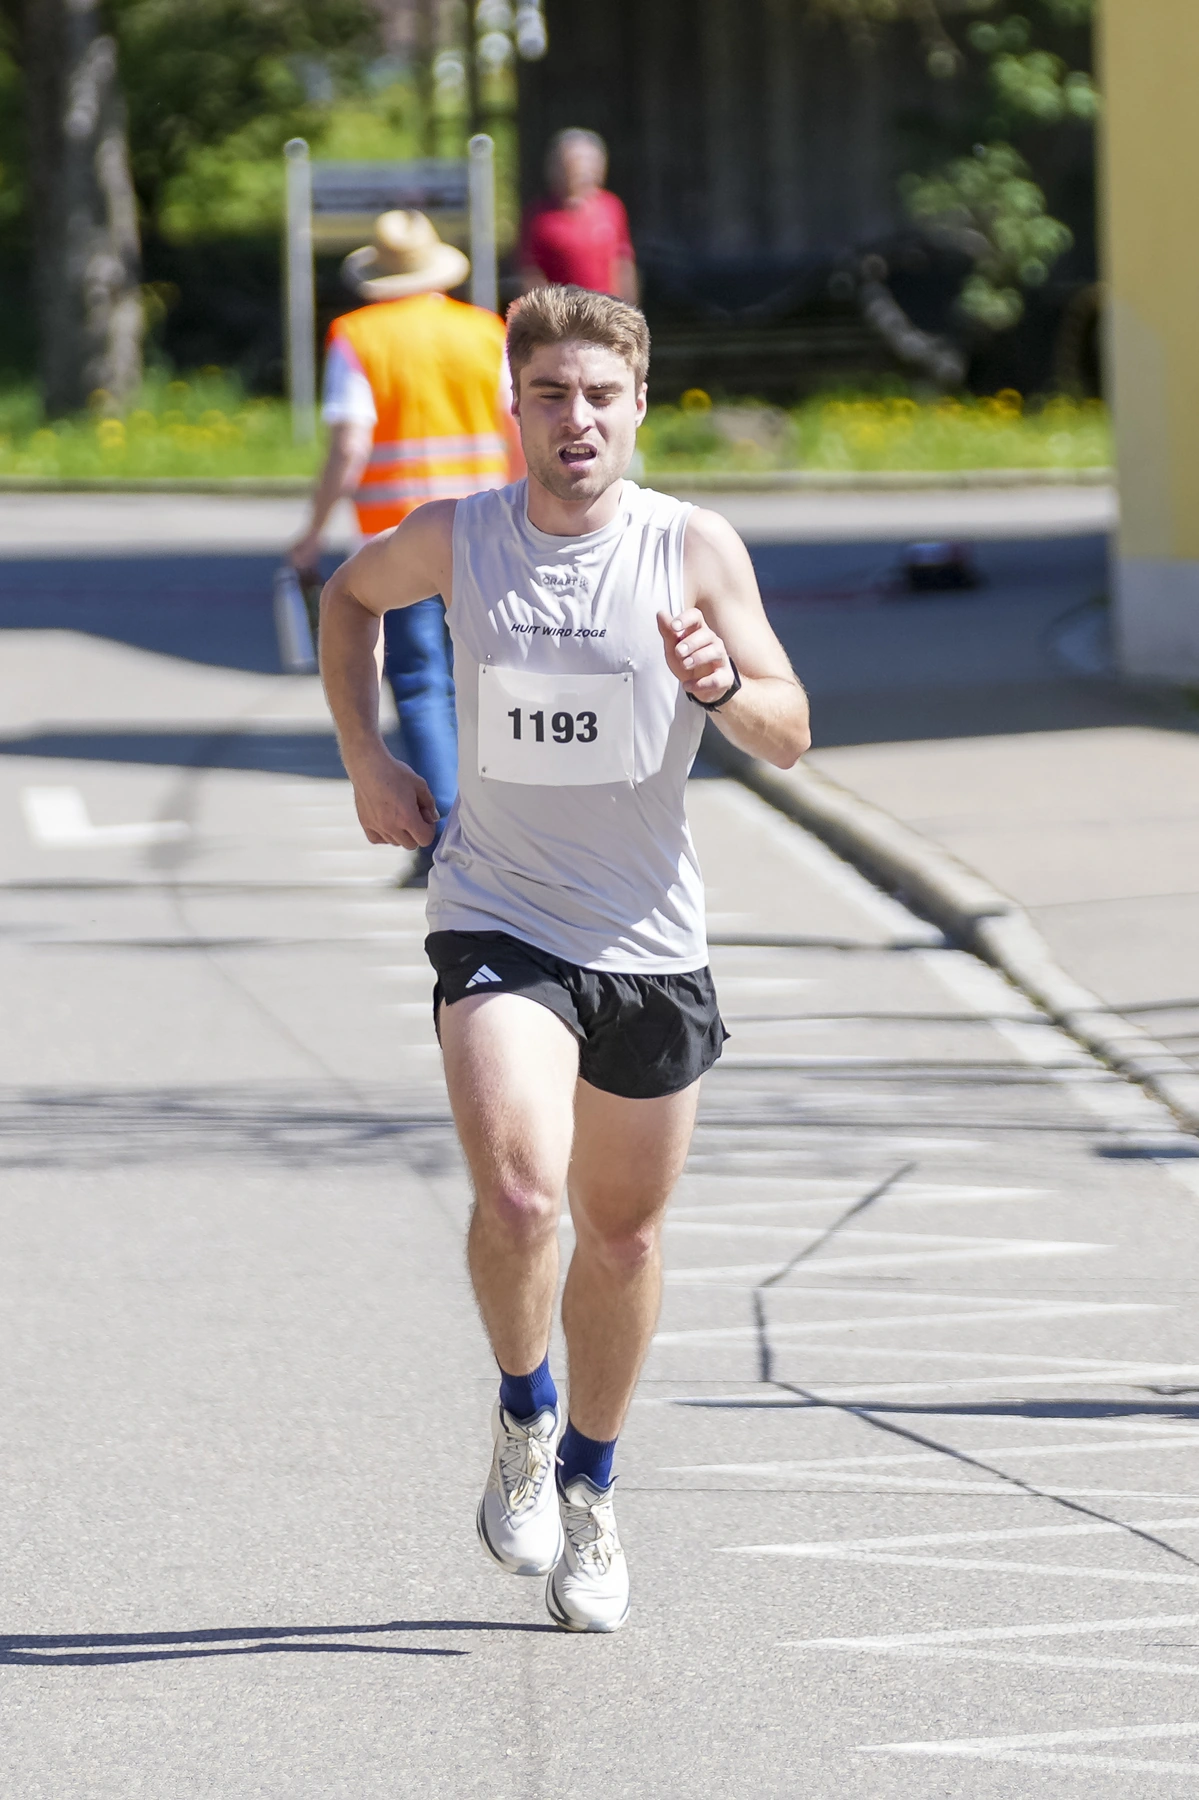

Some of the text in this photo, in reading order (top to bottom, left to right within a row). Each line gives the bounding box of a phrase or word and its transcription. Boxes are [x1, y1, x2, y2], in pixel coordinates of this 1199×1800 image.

[510, 623, 607, 638] HUIT WIRD ZOGE
[507, 707, 598, 744] 1193
